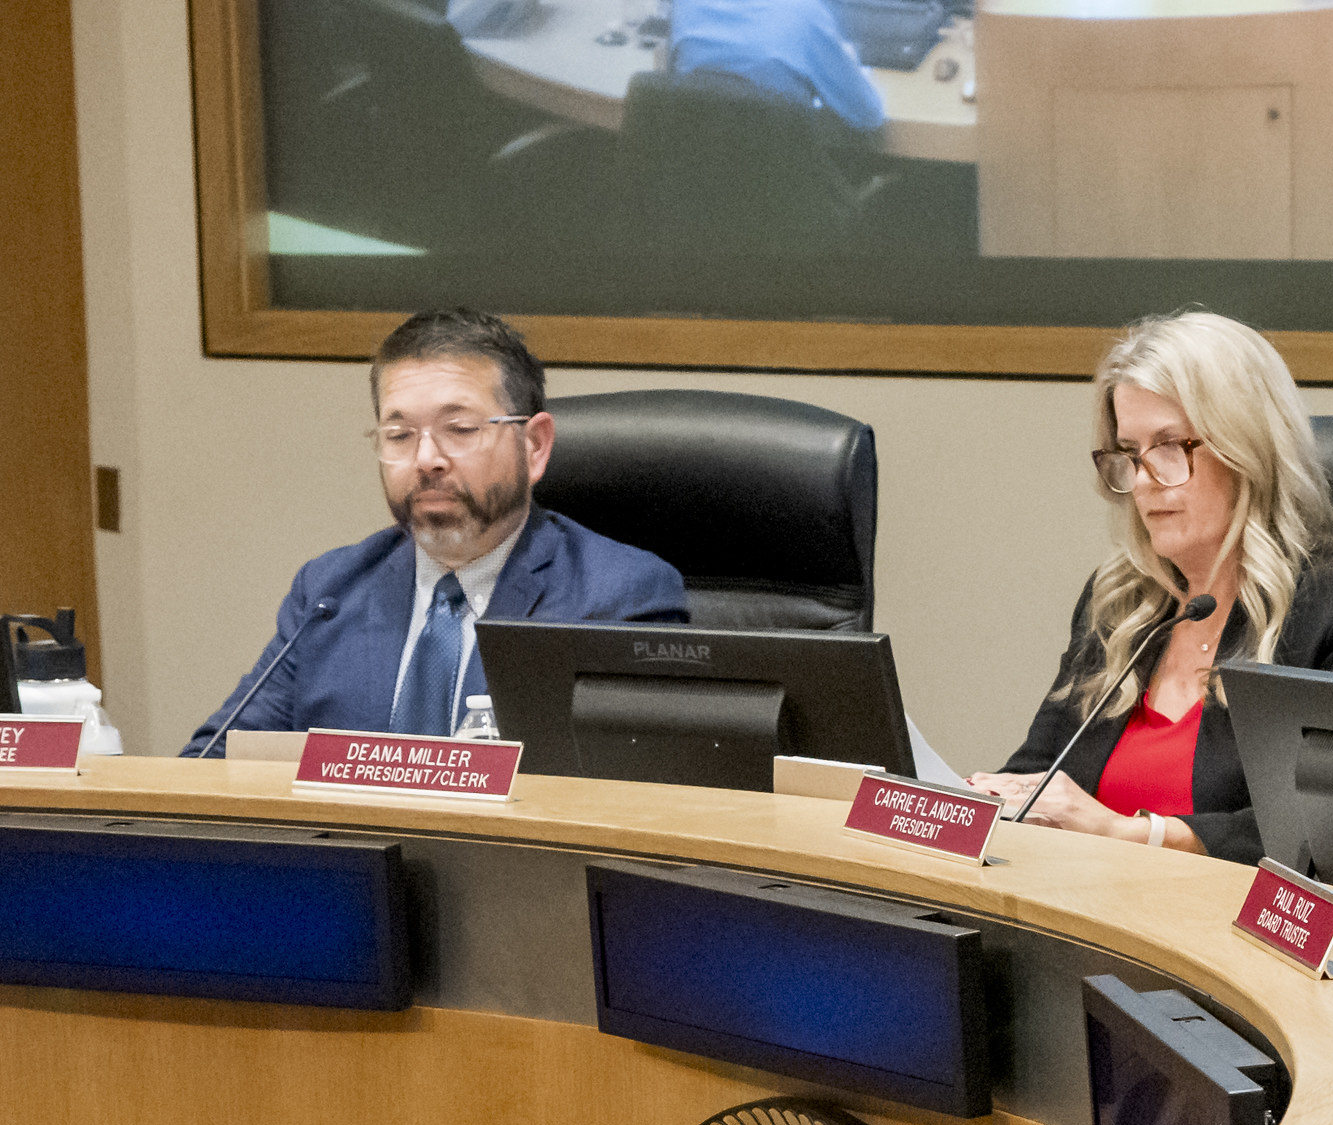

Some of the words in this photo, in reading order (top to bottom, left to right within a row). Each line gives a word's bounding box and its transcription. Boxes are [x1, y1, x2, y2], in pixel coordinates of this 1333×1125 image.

[633, 641, 711, 659] PLANAR
[0, 726, 25, 744] EY
[346, 742, 402, 763] DEANA
[407, 747, 472, 768] MILLER
[321, 762, 353, 779] VICE
[354, 765, 489, 788] PRESIDENT/CLERK
[874, 788, 917, 813] CARRIE
[914, 796, 976, 827] FLANDERS
[889, 815, 943, 840] PRESIDENT
[1272, 886, 1296, 914] PAUL
[1292, 896, 1316, 924] RUIZ
[1256, 908, 1283, 934] BOARD
[1279, 919, 1311, 950] TRUSTEE
